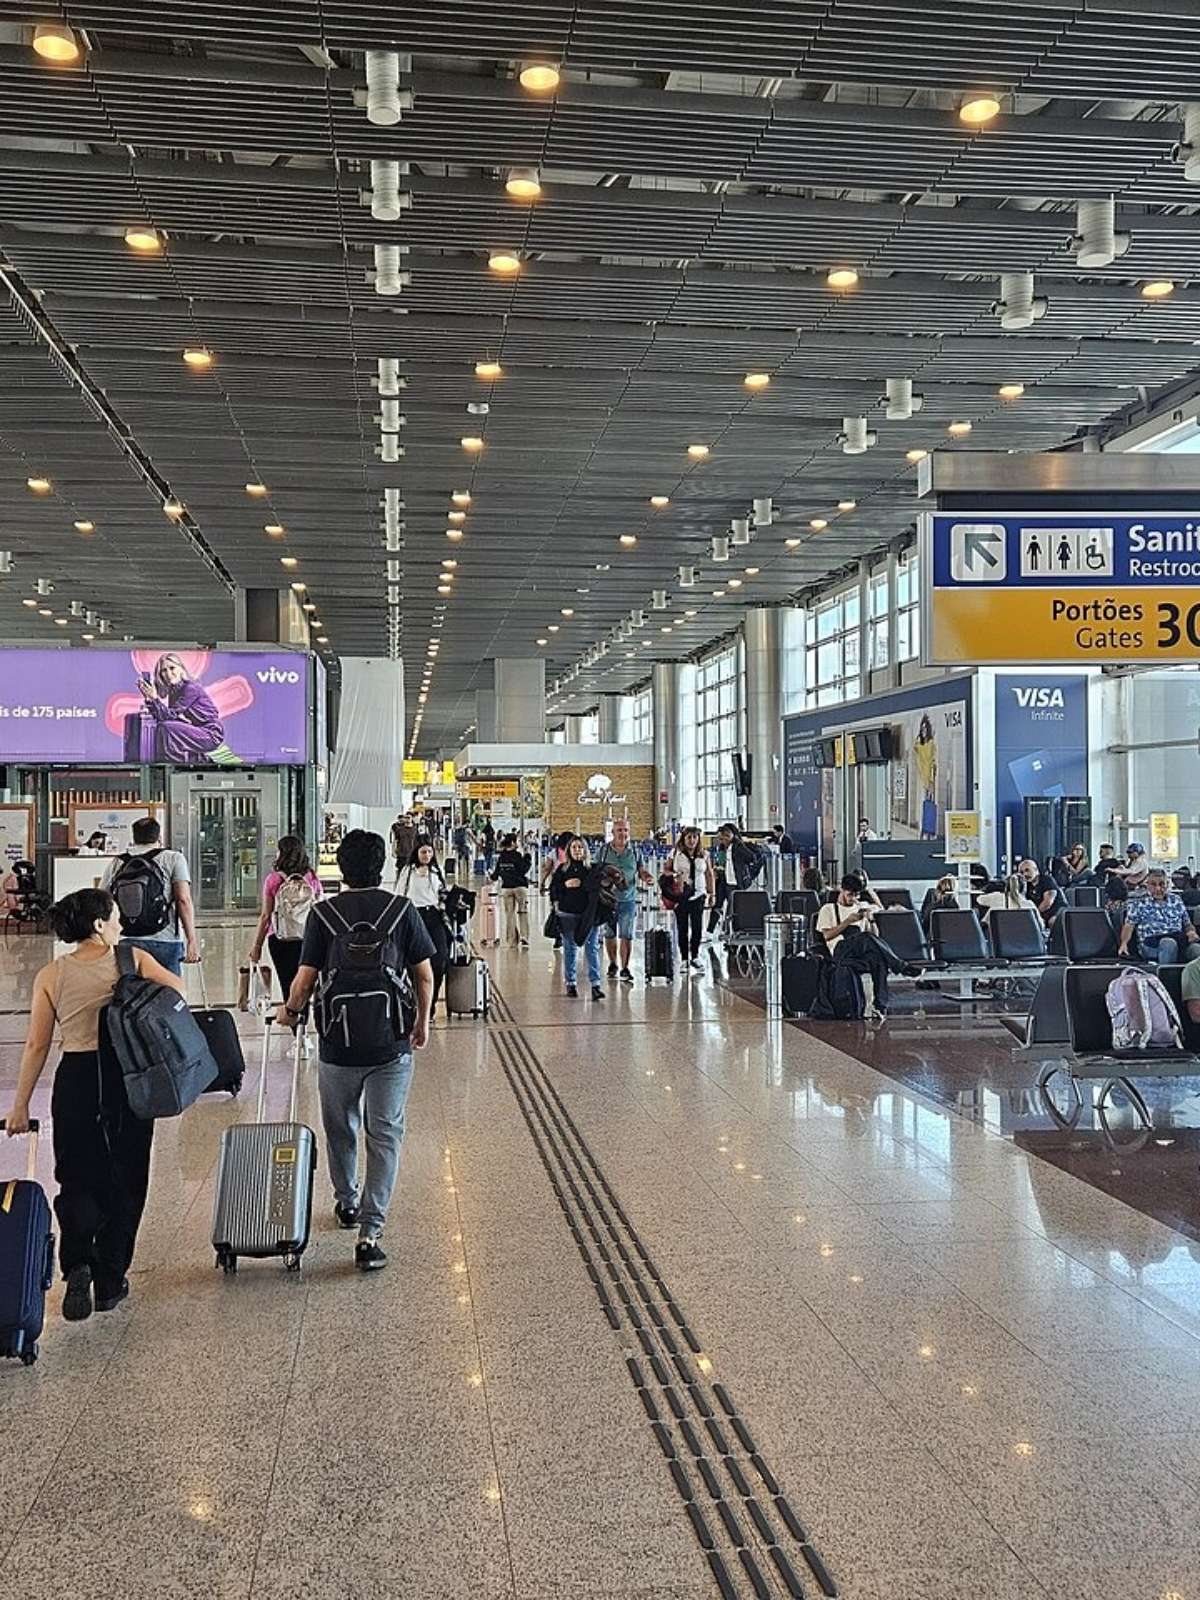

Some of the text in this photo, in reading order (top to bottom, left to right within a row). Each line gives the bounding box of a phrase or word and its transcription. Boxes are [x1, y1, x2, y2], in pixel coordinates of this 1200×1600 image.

[1052, 598, 1143, 621] Portões
[1076, 627, 1143, 649] Gates
[256, 666, 299, 684] vivo
[1011, 687, 1065, 708] VISA
[12, 705, 30, 718] de
[32, 706, 54, 718] 175
[944, 711, 962, 728] VISA
[1031, 710, 1065, 721] Infinite
